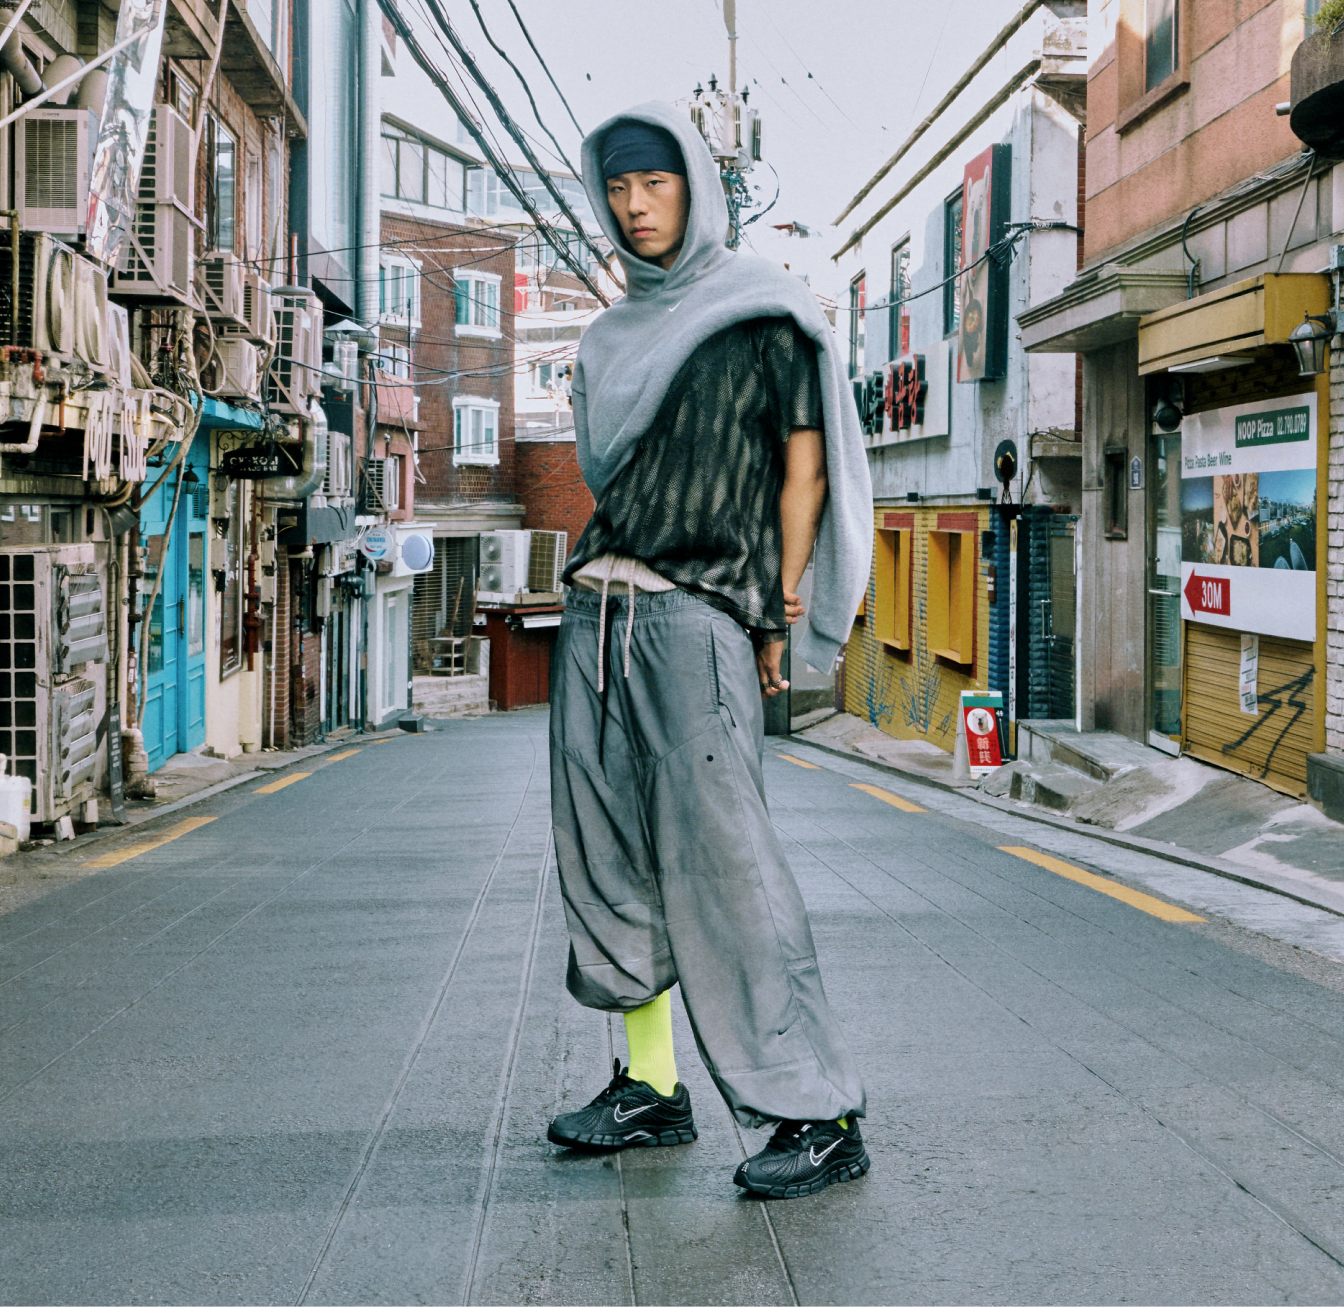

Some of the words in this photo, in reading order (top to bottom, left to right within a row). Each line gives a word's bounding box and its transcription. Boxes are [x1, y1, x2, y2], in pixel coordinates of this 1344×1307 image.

[1237, 420, 1256, 441] NOOP
[1257, 418, 1274, 438] Pizza
[1207, 453, 1218, 468] Beer
[1219, 451, 1232, 467] Wine
[1201, 580, 1222, 610] 30M
